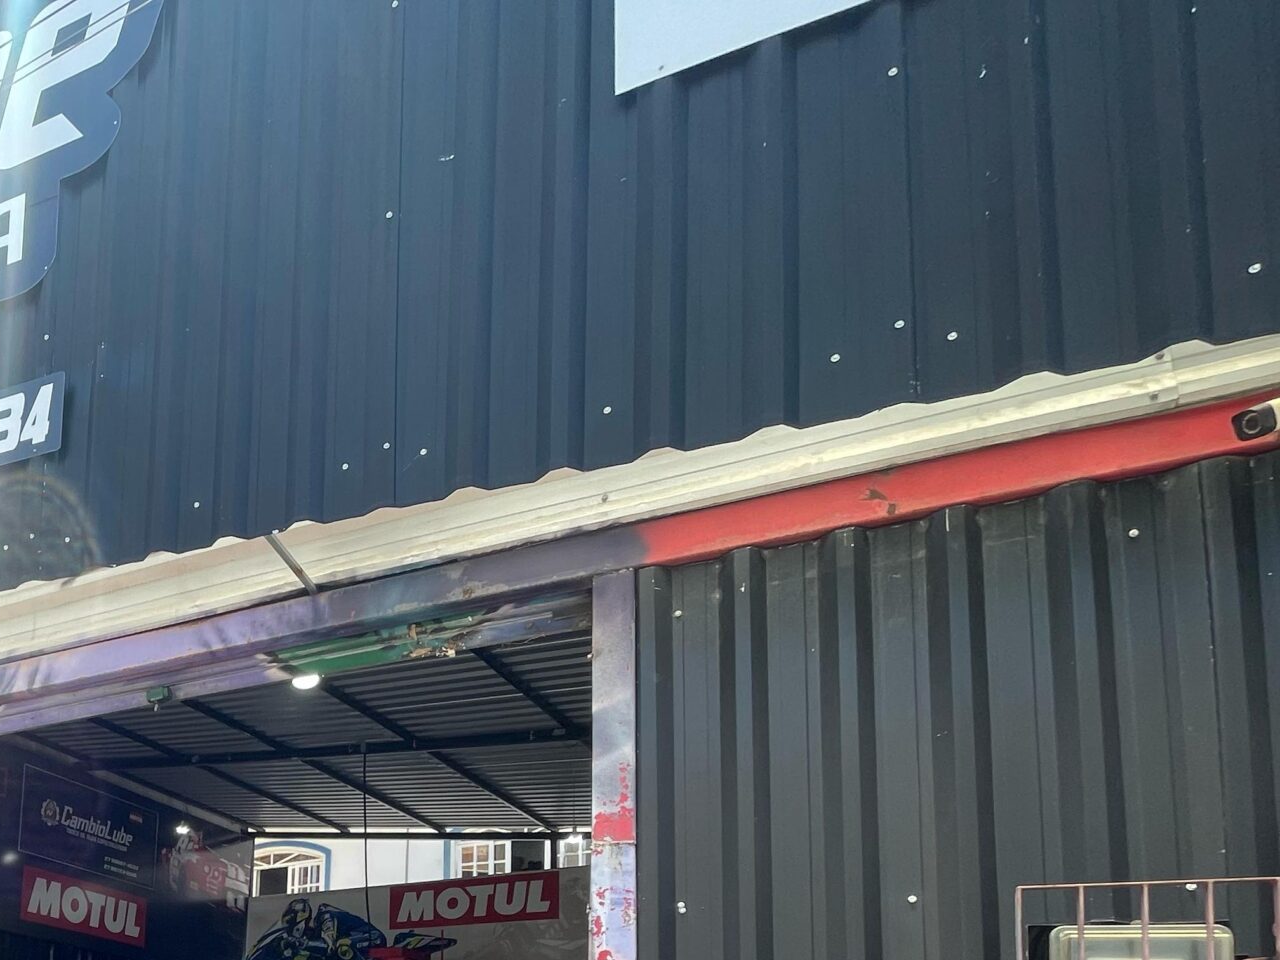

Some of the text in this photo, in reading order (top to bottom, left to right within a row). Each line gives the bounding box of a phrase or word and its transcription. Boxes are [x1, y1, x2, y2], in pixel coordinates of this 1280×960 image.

[61, 806, 133, 847] CambioLube
[27, 877, 141, 937] MOTUL
[396, 879, 551, 923] MOTUL
